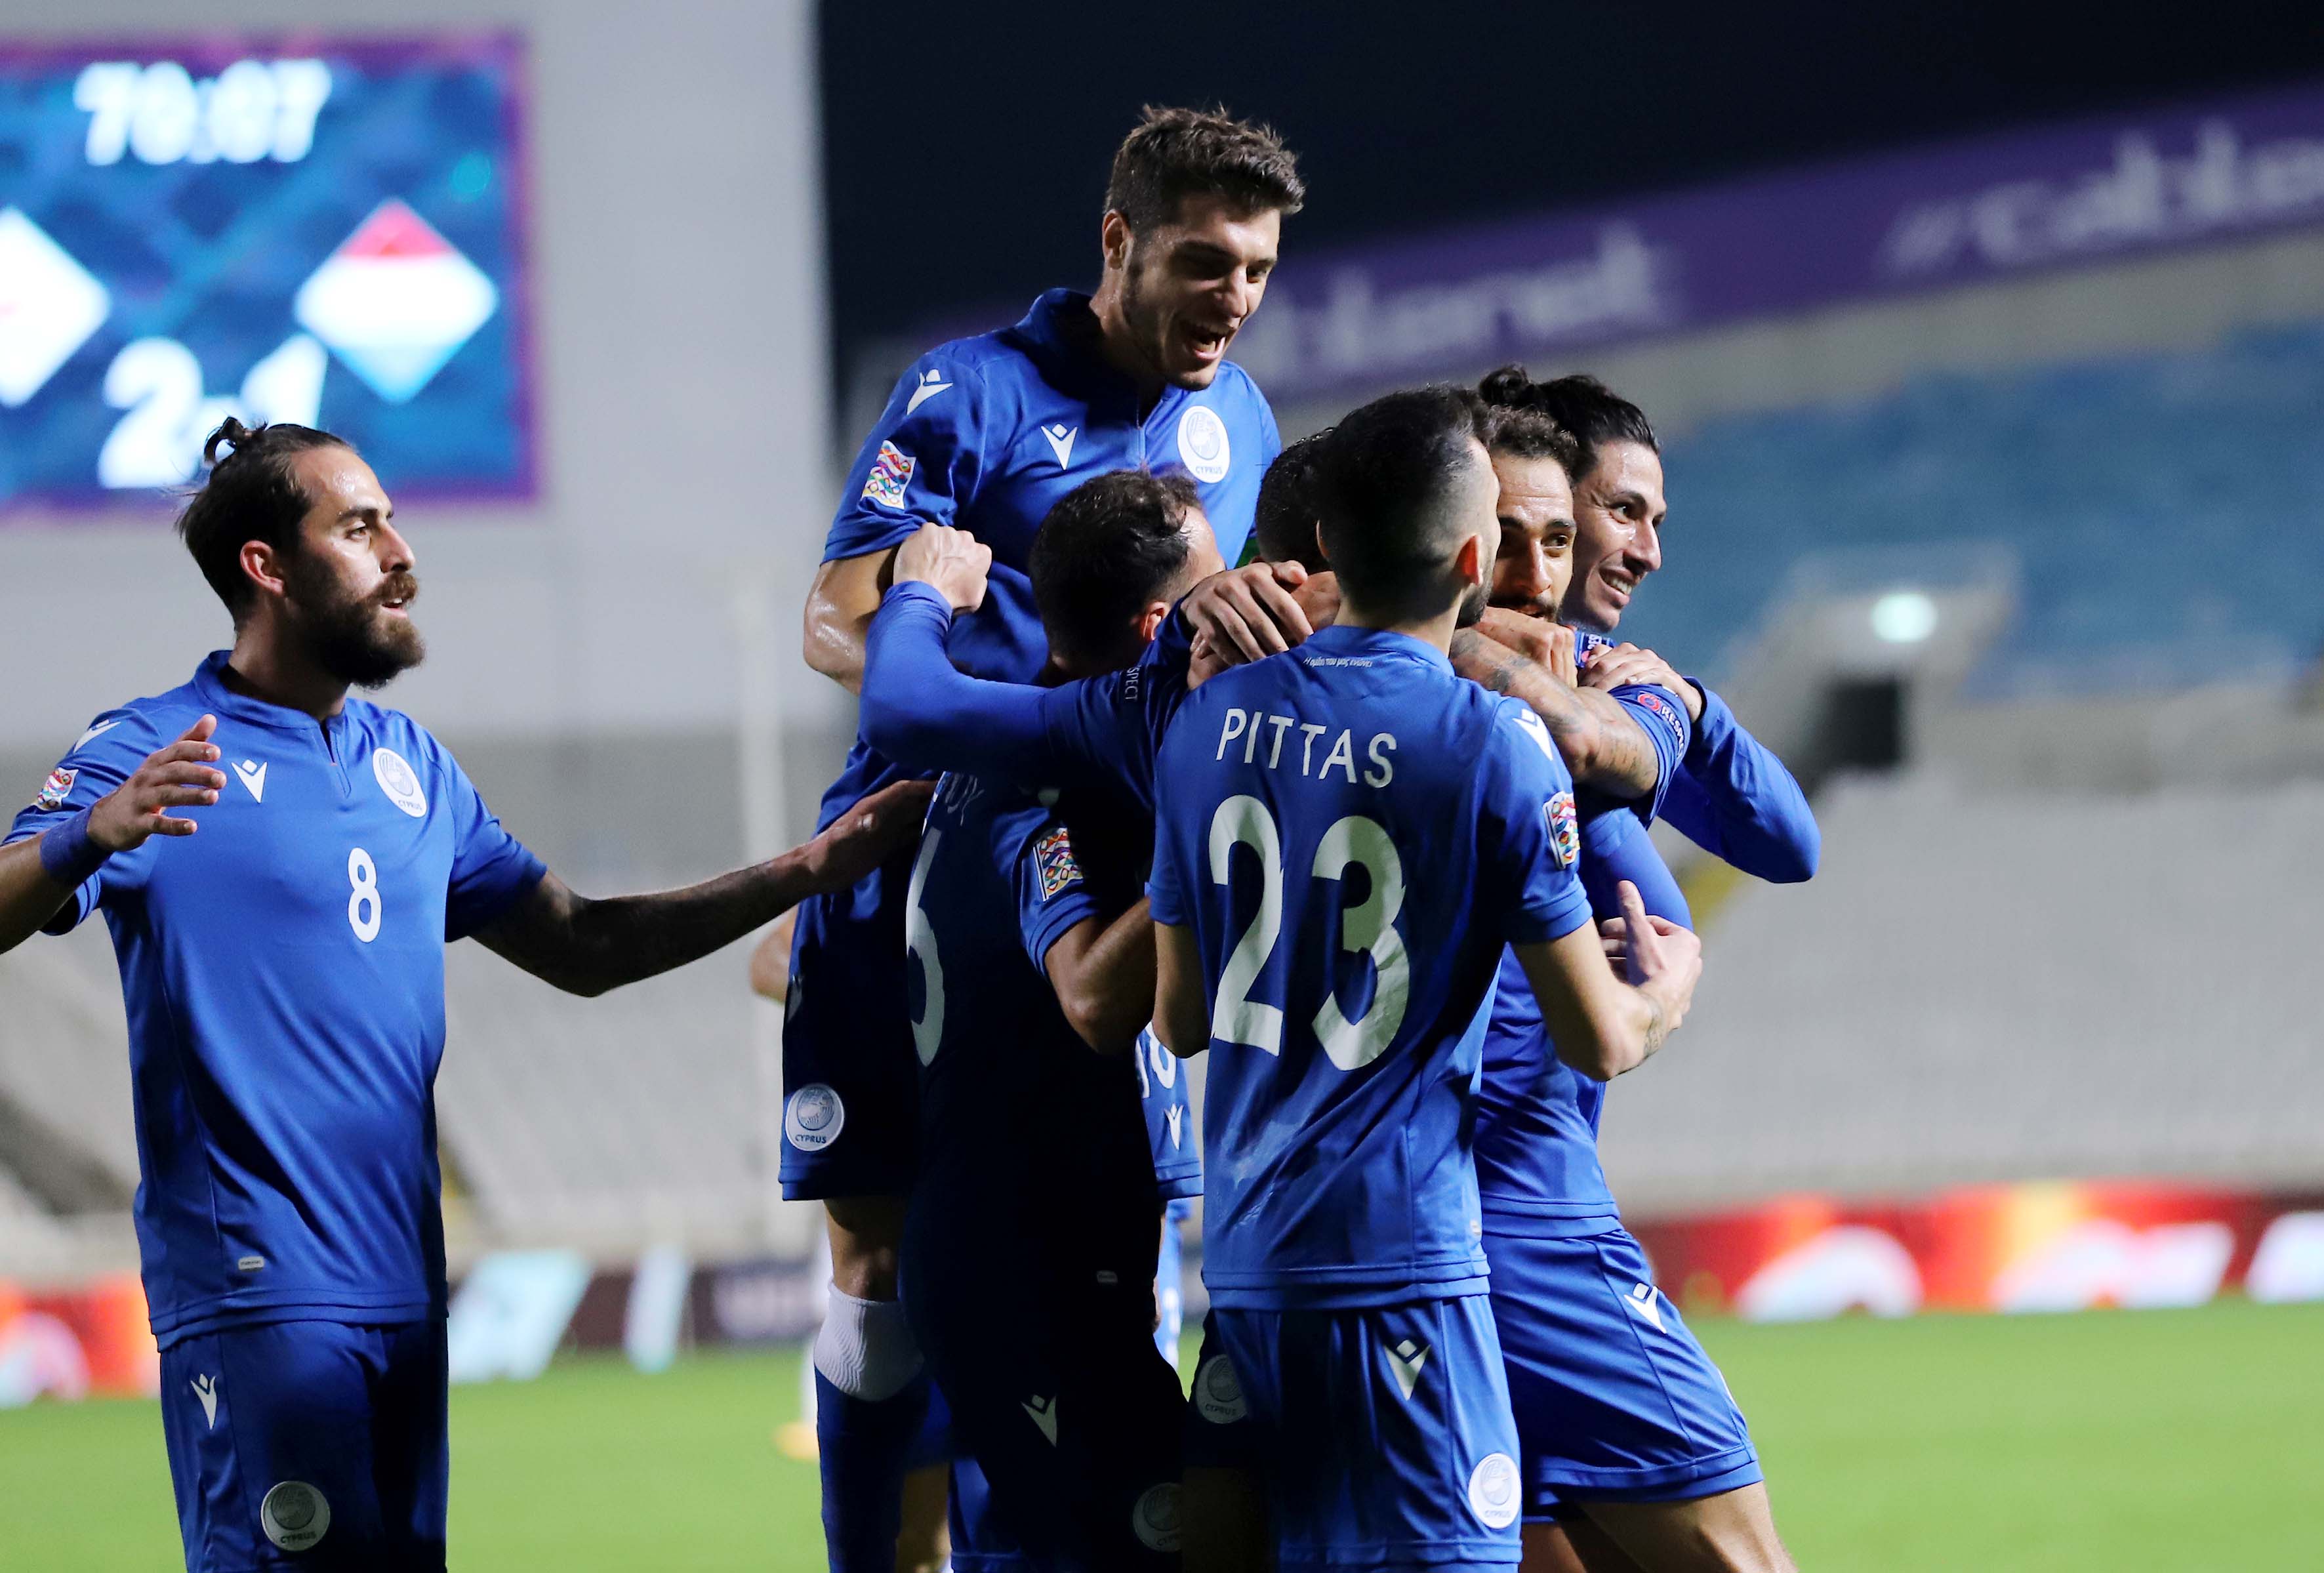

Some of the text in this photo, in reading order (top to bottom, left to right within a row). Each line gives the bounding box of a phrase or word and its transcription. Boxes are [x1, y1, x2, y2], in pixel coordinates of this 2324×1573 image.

[1195, 465, 1223, 475] CYPRUS
[1125, 665, 1141, 702] SPECT
[1215, 708, 1398, 788] PITTAS
[348, 847, 383, 943] 8
[1209, 794, 1410, 1071] 23
[794, 1134, 827, 1145] CYPRUS
[1205, 1403, 1237, 1417] CYPRUS
[280, 1530, 317, 1544] CYPRUS
